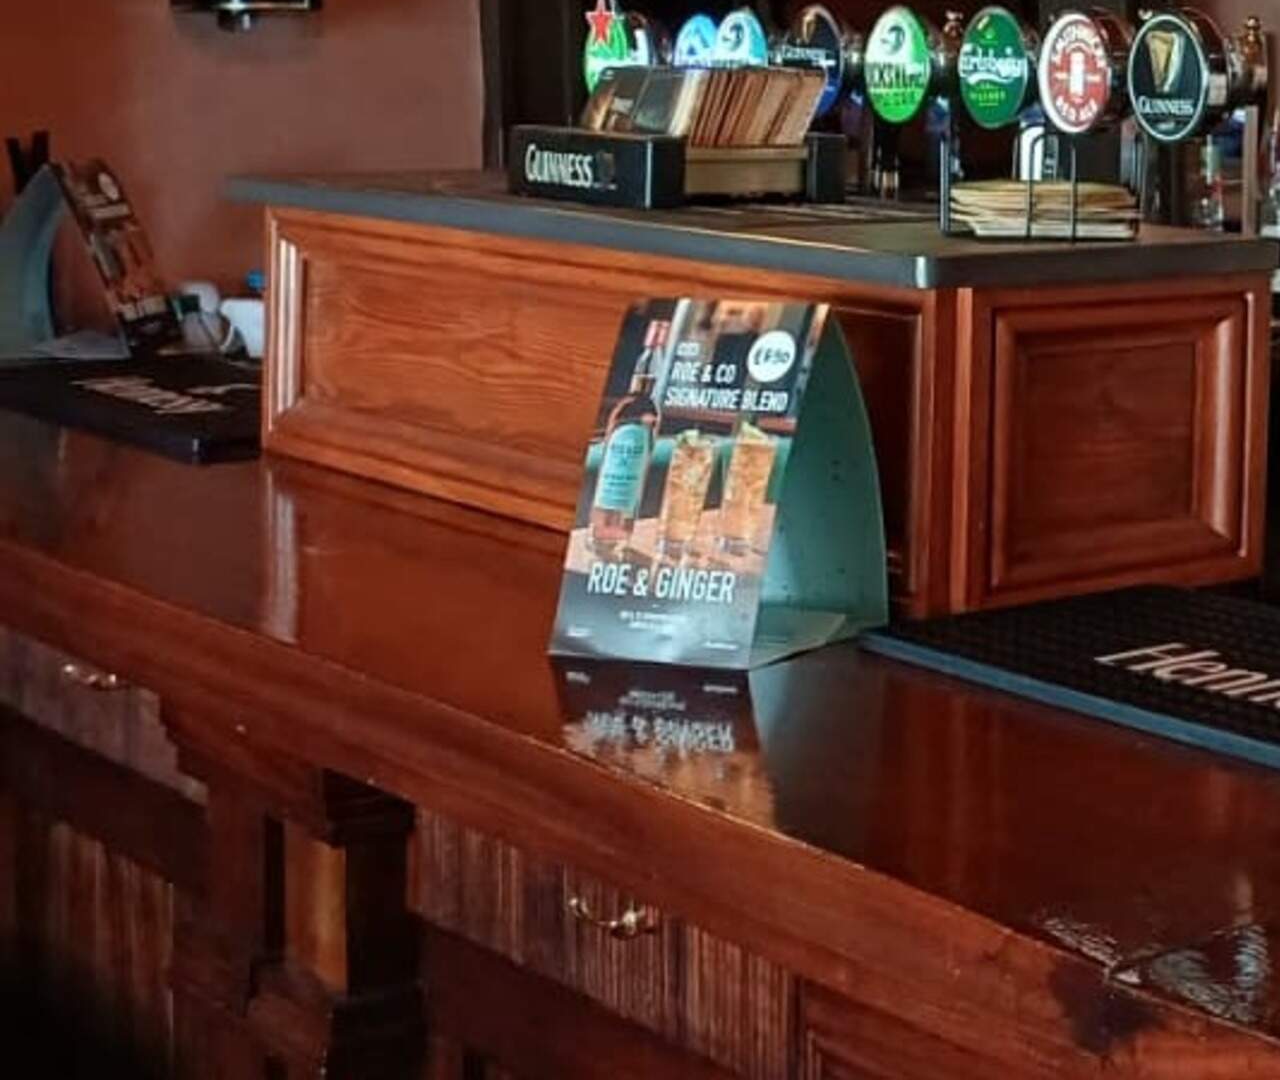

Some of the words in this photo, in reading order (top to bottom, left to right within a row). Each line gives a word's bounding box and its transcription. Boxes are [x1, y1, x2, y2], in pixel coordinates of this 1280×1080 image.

[1137, 96, 1195, 116] GUINNESS
[524, 143, 594, 189] GUINNESS
[741, 388, 789, 412] BLEND
[587, 561, 632, 596] ROE
[632, 567, 649, 597] &
[654, 566, 736, 604] GINGER
